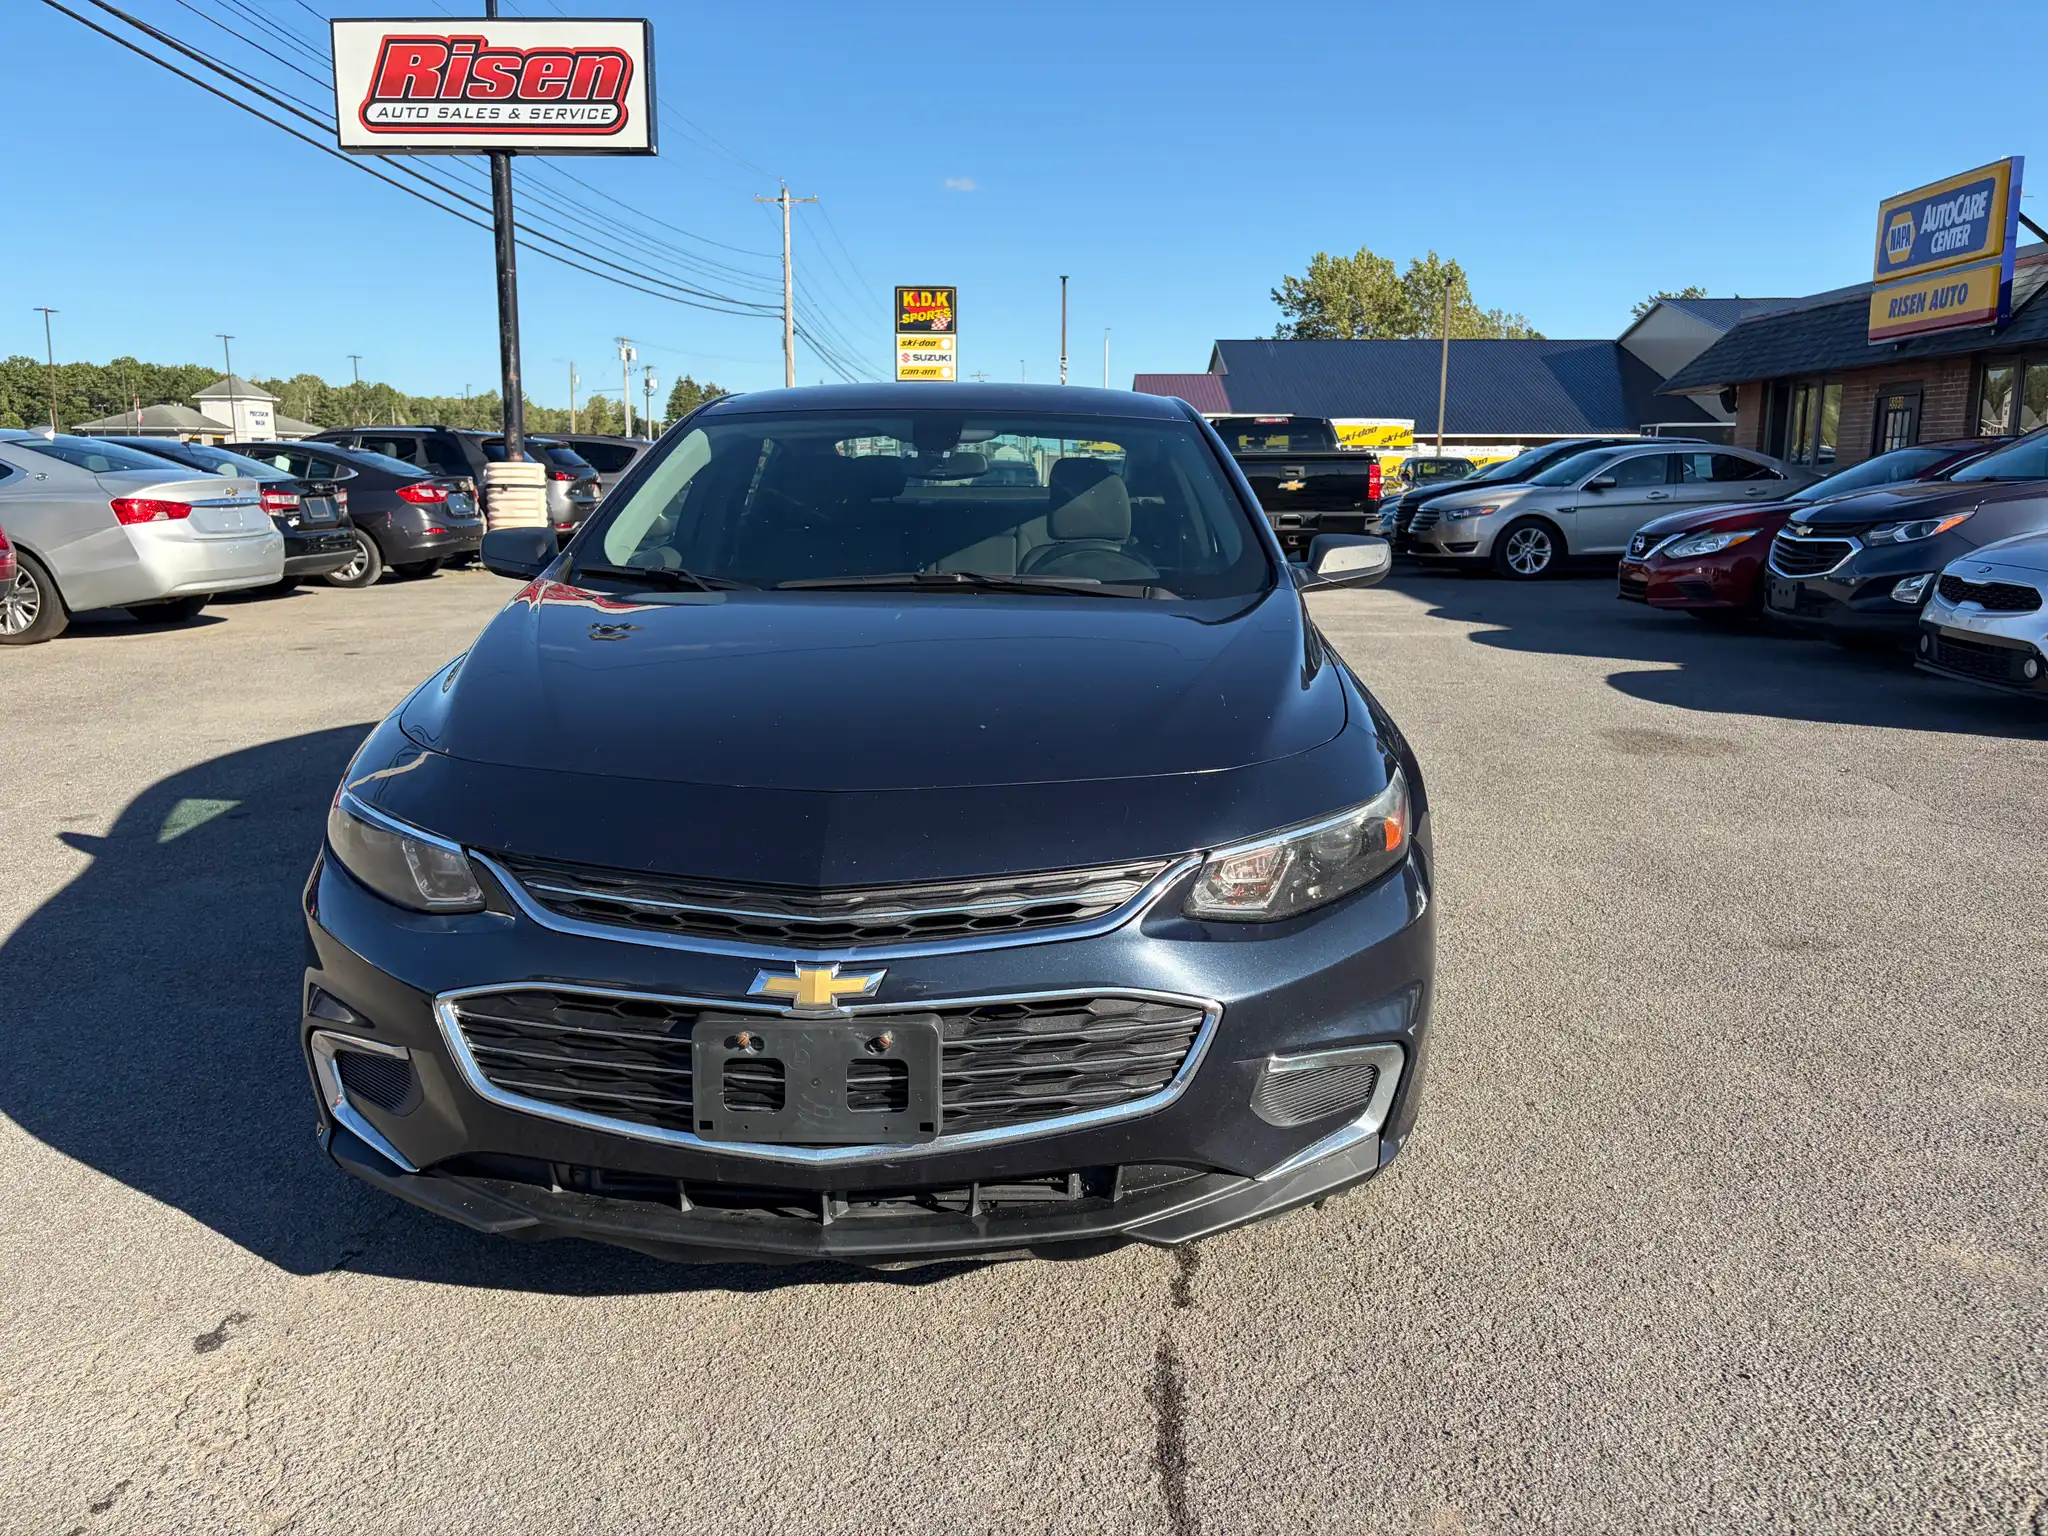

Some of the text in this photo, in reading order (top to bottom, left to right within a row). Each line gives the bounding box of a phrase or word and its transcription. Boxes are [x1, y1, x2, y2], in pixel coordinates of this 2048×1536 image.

[375, 43, 624, 100] Risen
[376, 106, 613, 120] AUTO SALES & SERVICE
[1889, 223, 1912, 252] NAPA
[1931, 223, 1971, 254] CENTER
[903, 291, 949, 307] K.D.K
[1888, 283, 1969, 319] RISEN AUTO
[902, 307, 952, 324] SPORTS
[900, 339, 937, 347] ski-doo
